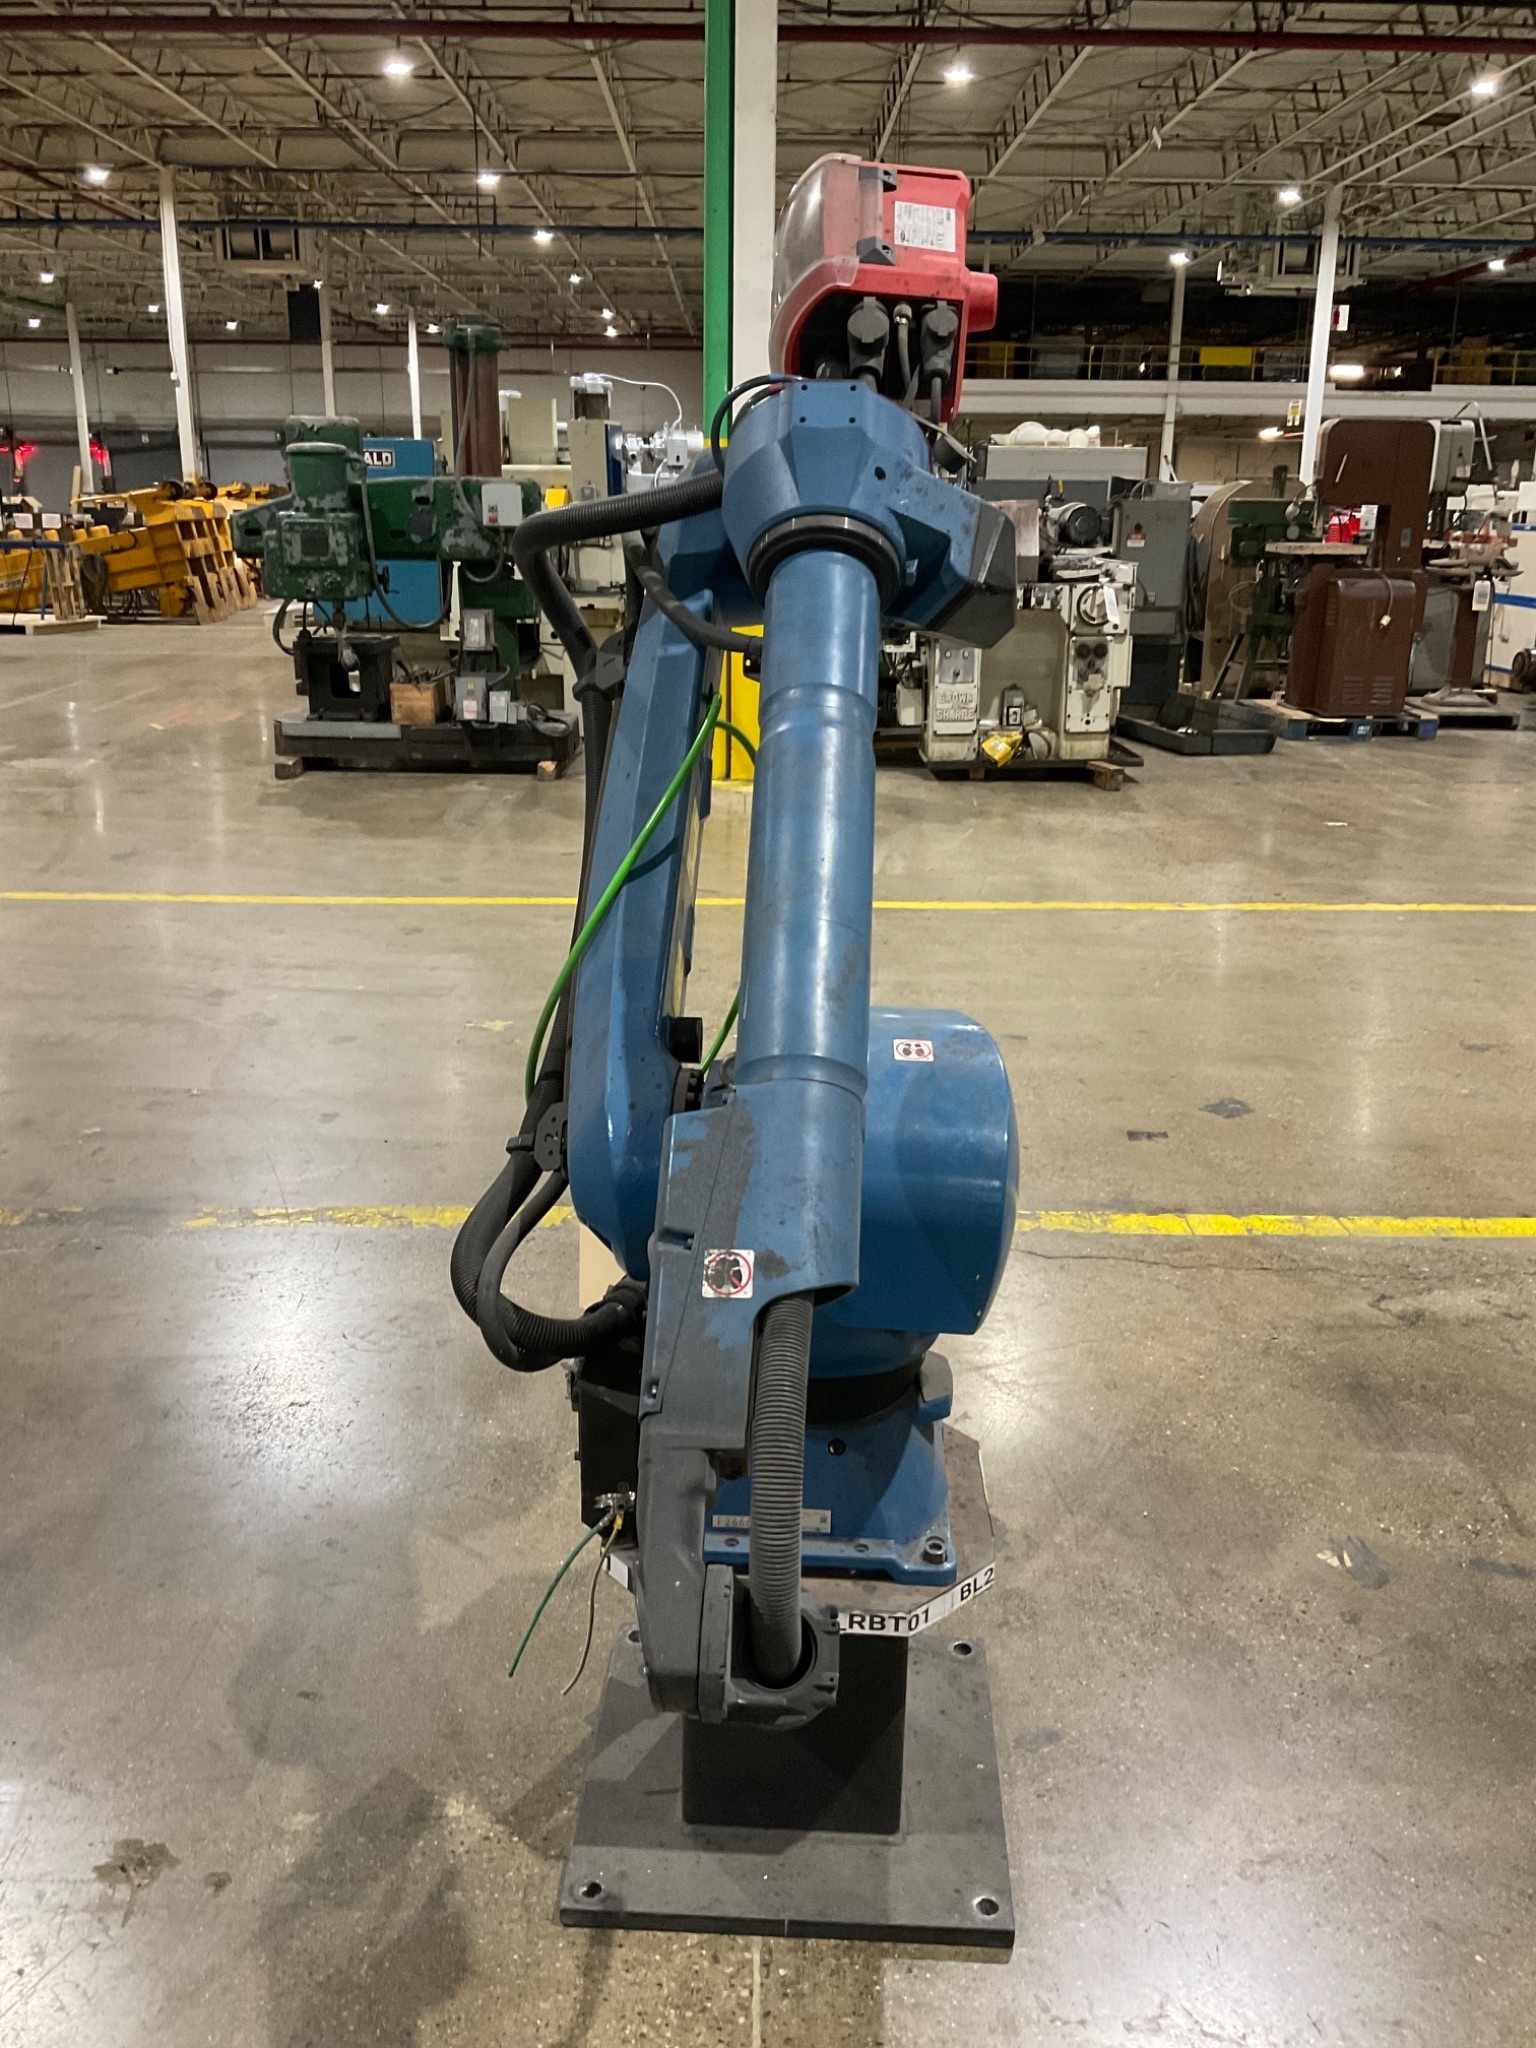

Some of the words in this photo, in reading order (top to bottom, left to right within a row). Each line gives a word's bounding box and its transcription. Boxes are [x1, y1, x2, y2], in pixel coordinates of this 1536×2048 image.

[938, 692, 974, 704] BROWN
[936, 709, 975, 721] SHARPE
[960, 1567, 994, 1602] BL2
